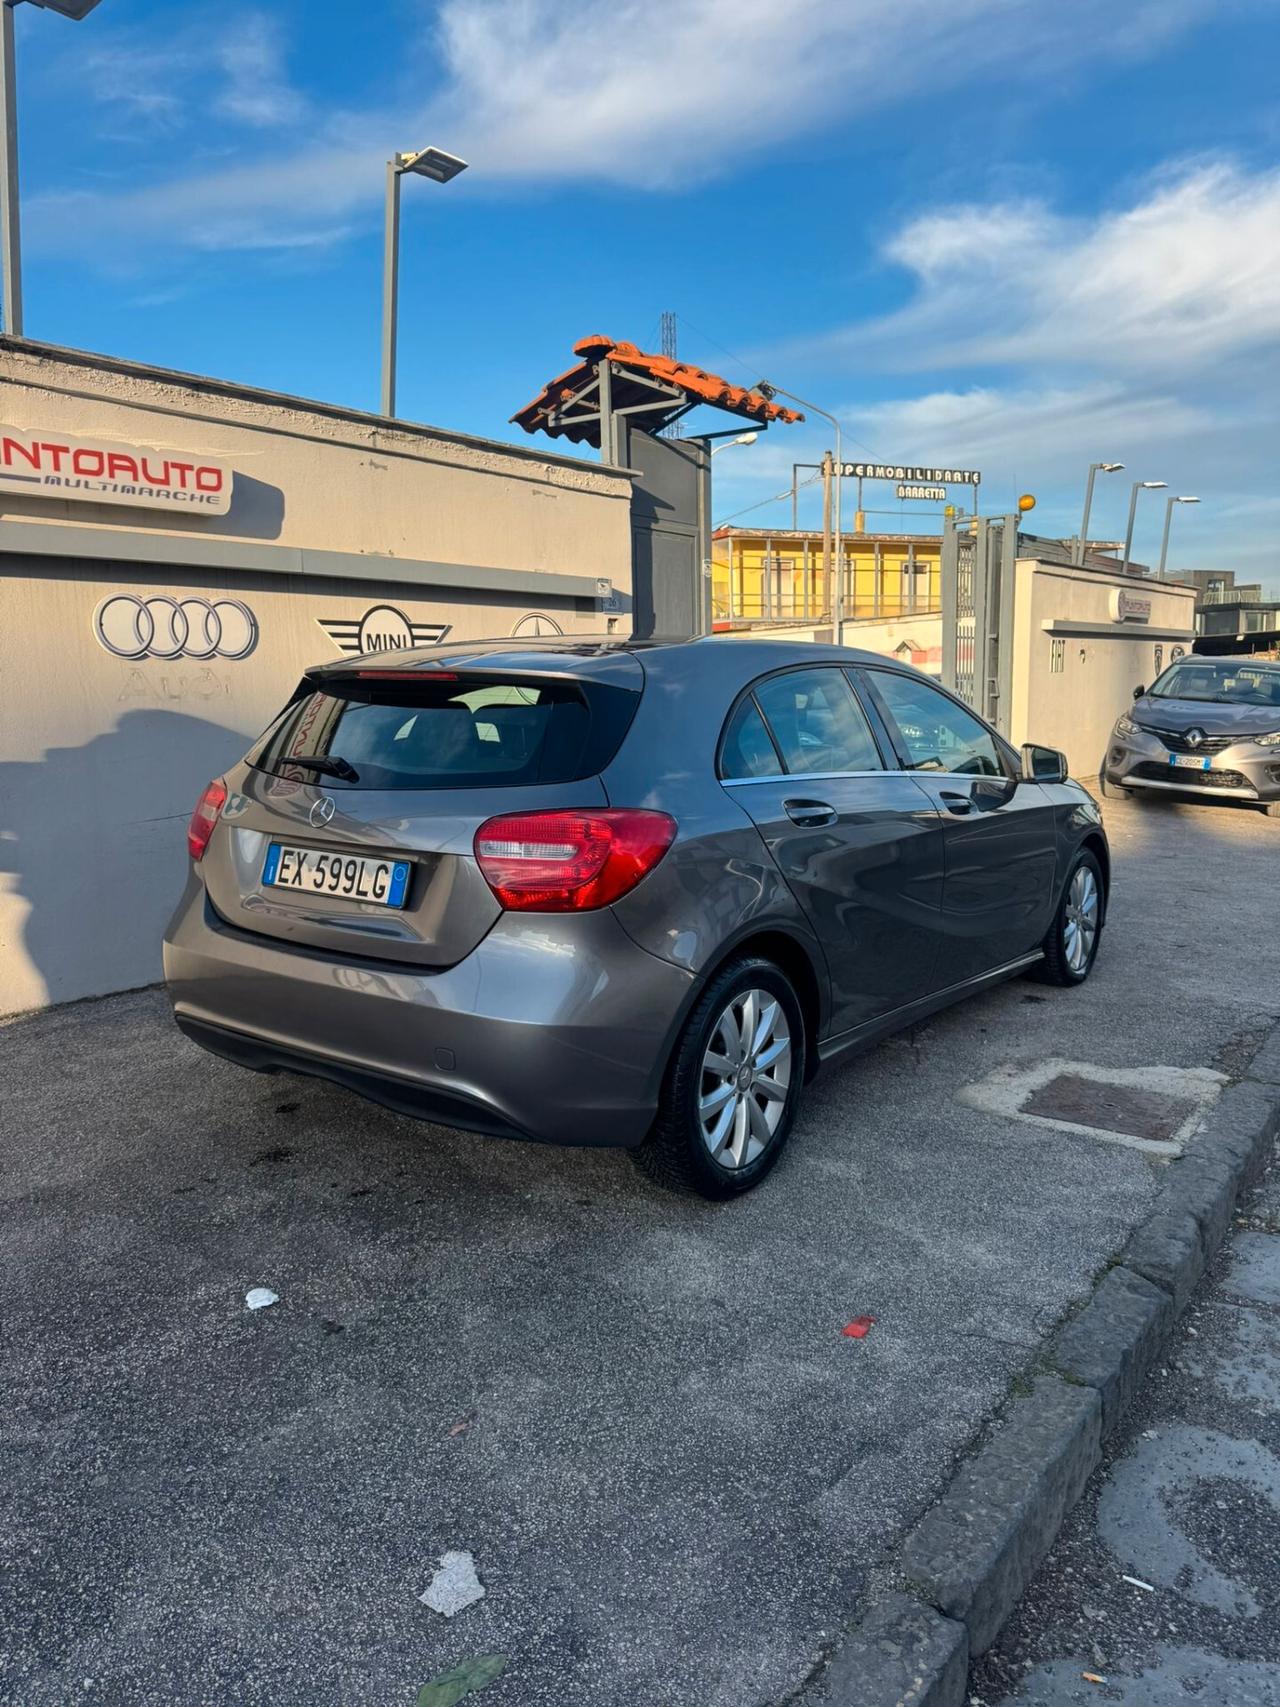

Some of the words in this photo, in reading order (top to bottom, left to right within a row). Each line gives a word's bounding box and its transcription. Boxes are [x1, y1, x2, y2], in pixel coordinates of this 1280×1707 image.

[0, 437, 222, 492] NTOAUTO
[823, 463, 979, 484] UPERMOBILIDARTE
[44, 475, 220, 505] MULTIMARCHE
[366, 633, 407, 651] MINI
[277, 850, 308, 886] EX
[313, 855, 389, 899] 599LG
